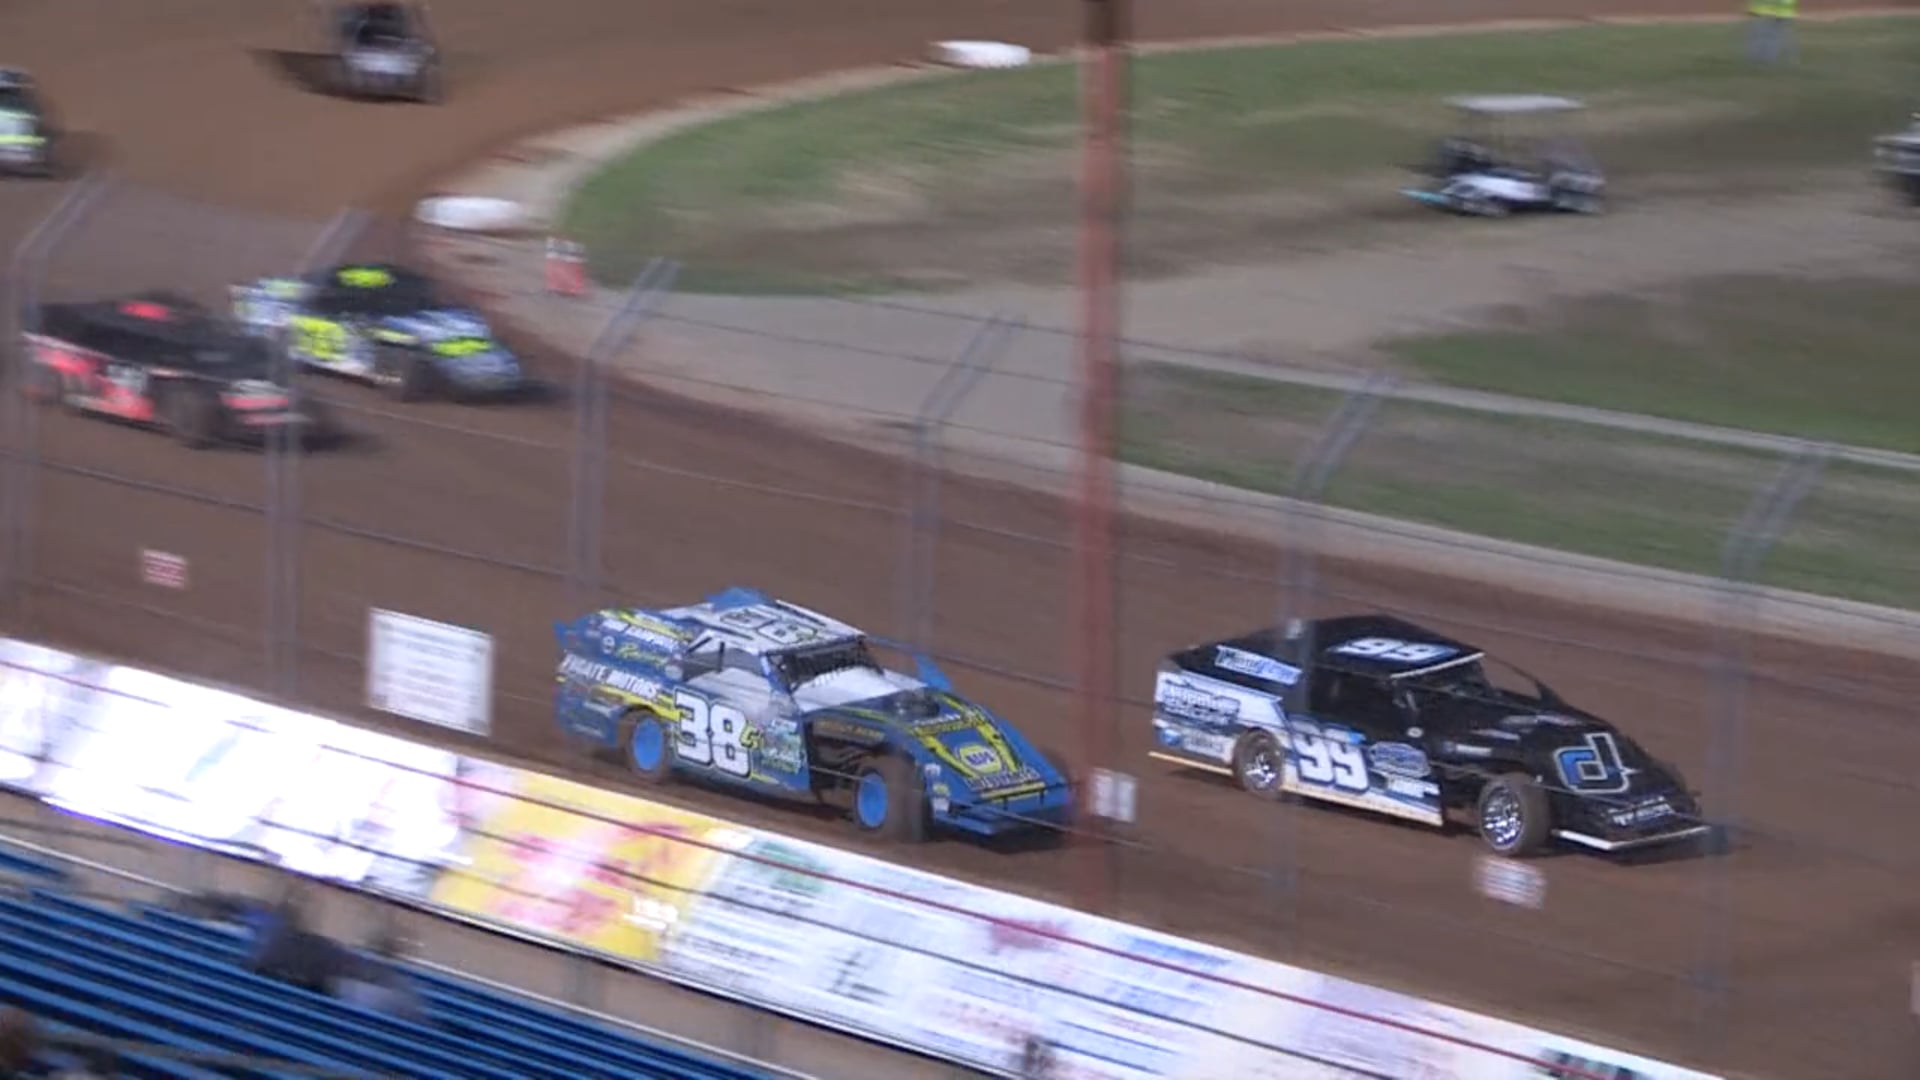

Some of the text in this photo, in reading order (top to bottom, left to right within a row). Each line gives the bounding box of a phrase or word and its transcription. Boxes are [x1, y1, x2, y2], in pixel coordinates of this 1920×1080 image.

[1335, 637, 1444, 662] 99
[674, 689, 751, 778] 38
[1289, 718, 1370, 793] 99
